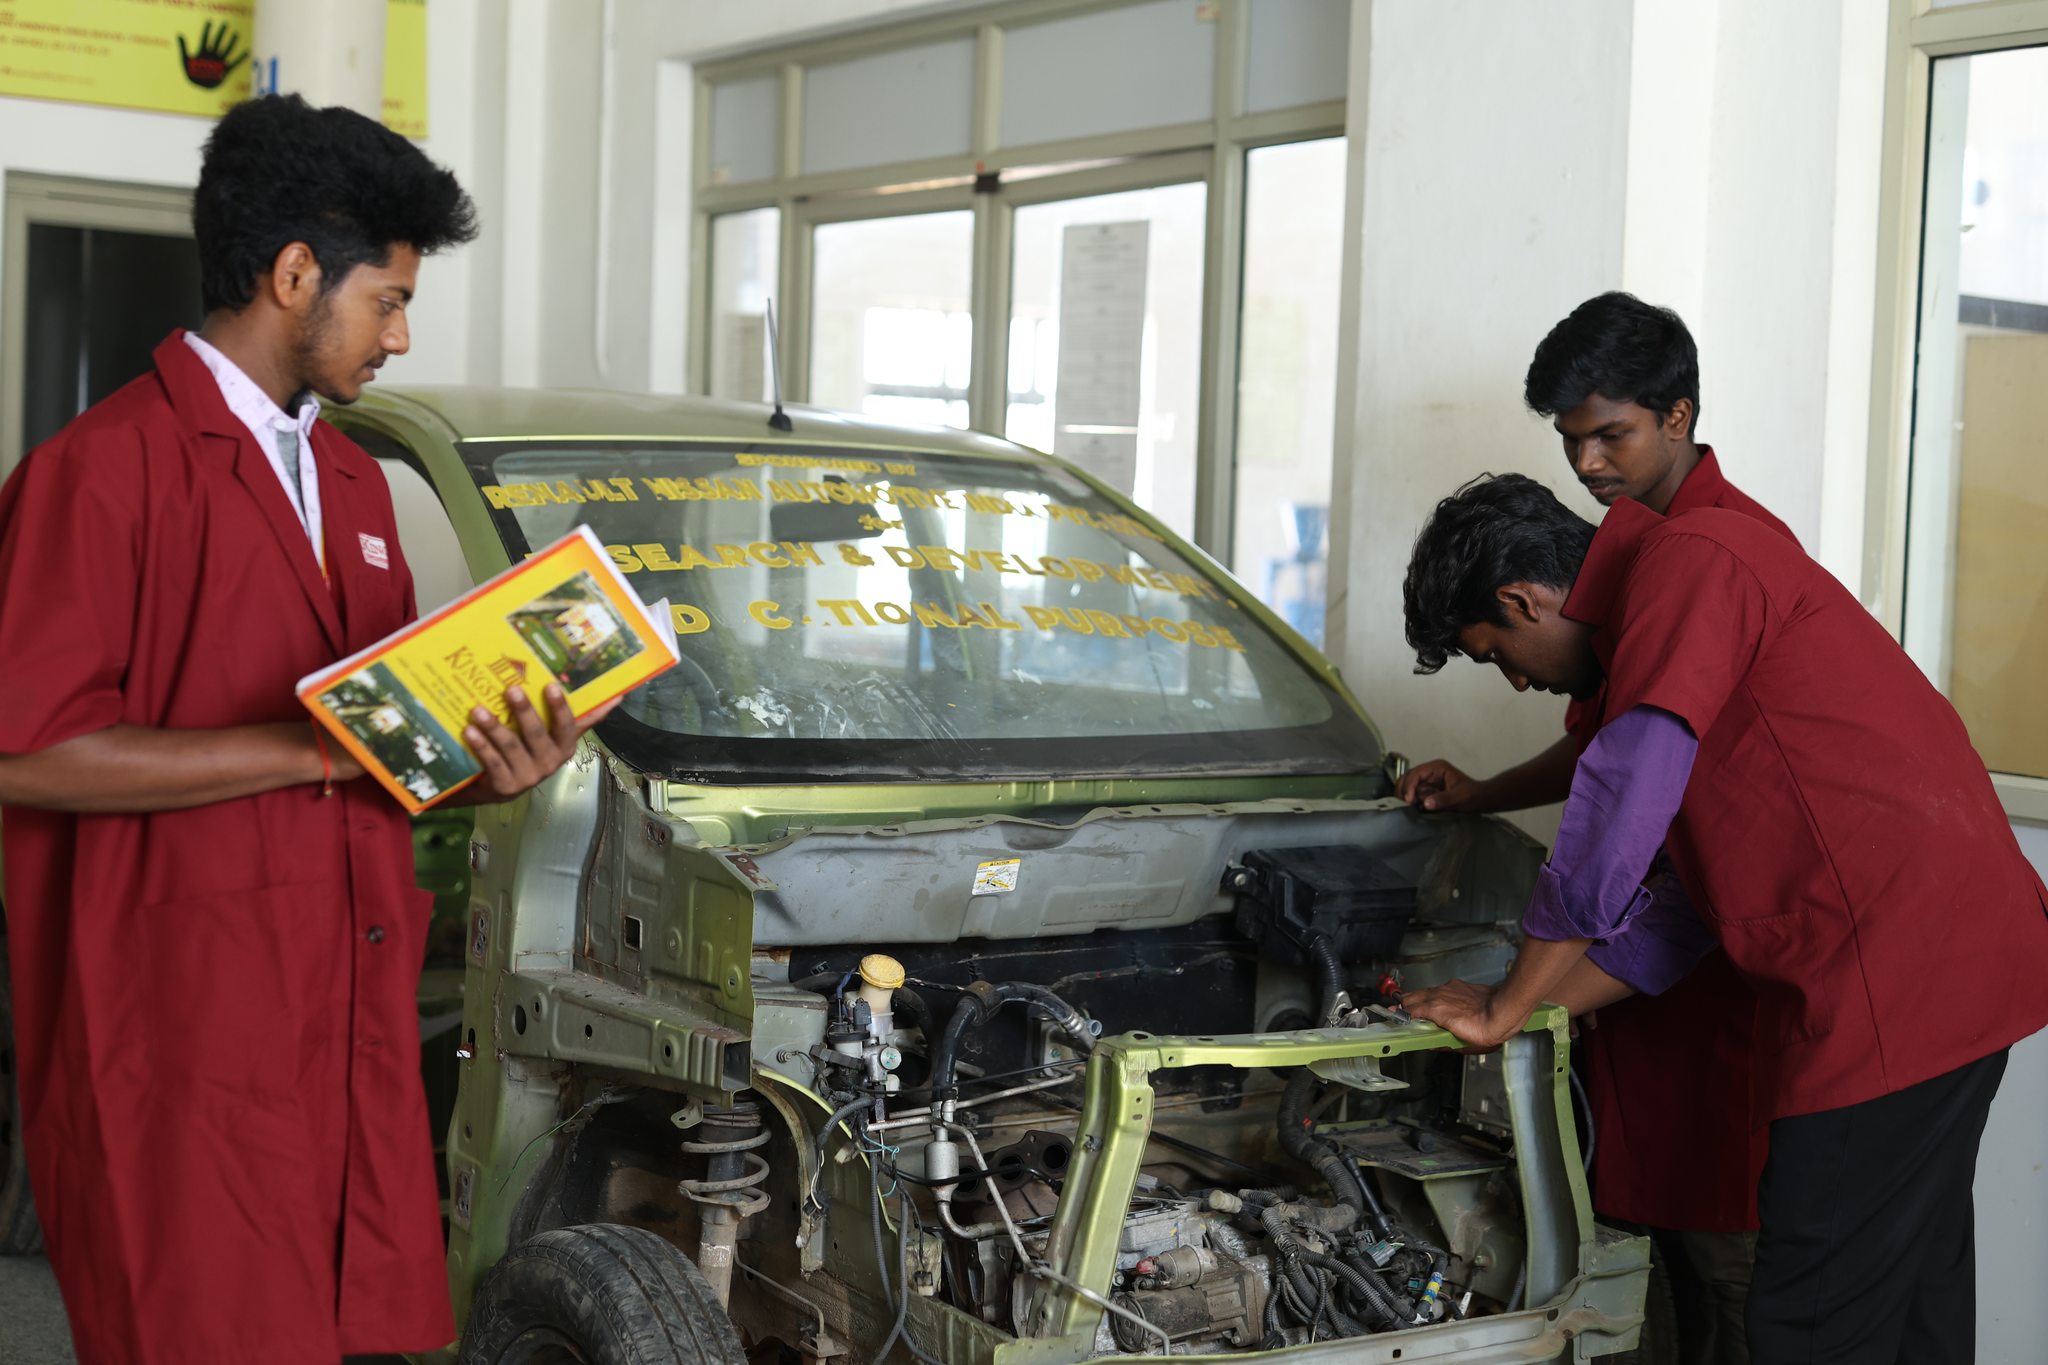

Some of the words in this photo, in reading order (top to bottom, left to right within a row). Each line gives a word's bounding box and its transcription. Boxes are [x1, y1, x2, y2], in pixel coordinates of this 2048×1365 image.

[481, 477, 639, 509] RENAULT
[641, 476, 765, 501] NISSAN
[525, 541, 824, 573] SEARCH
[838, 543, 875, 567] &
[1022, 605, 1248, 653] PURPOSE
